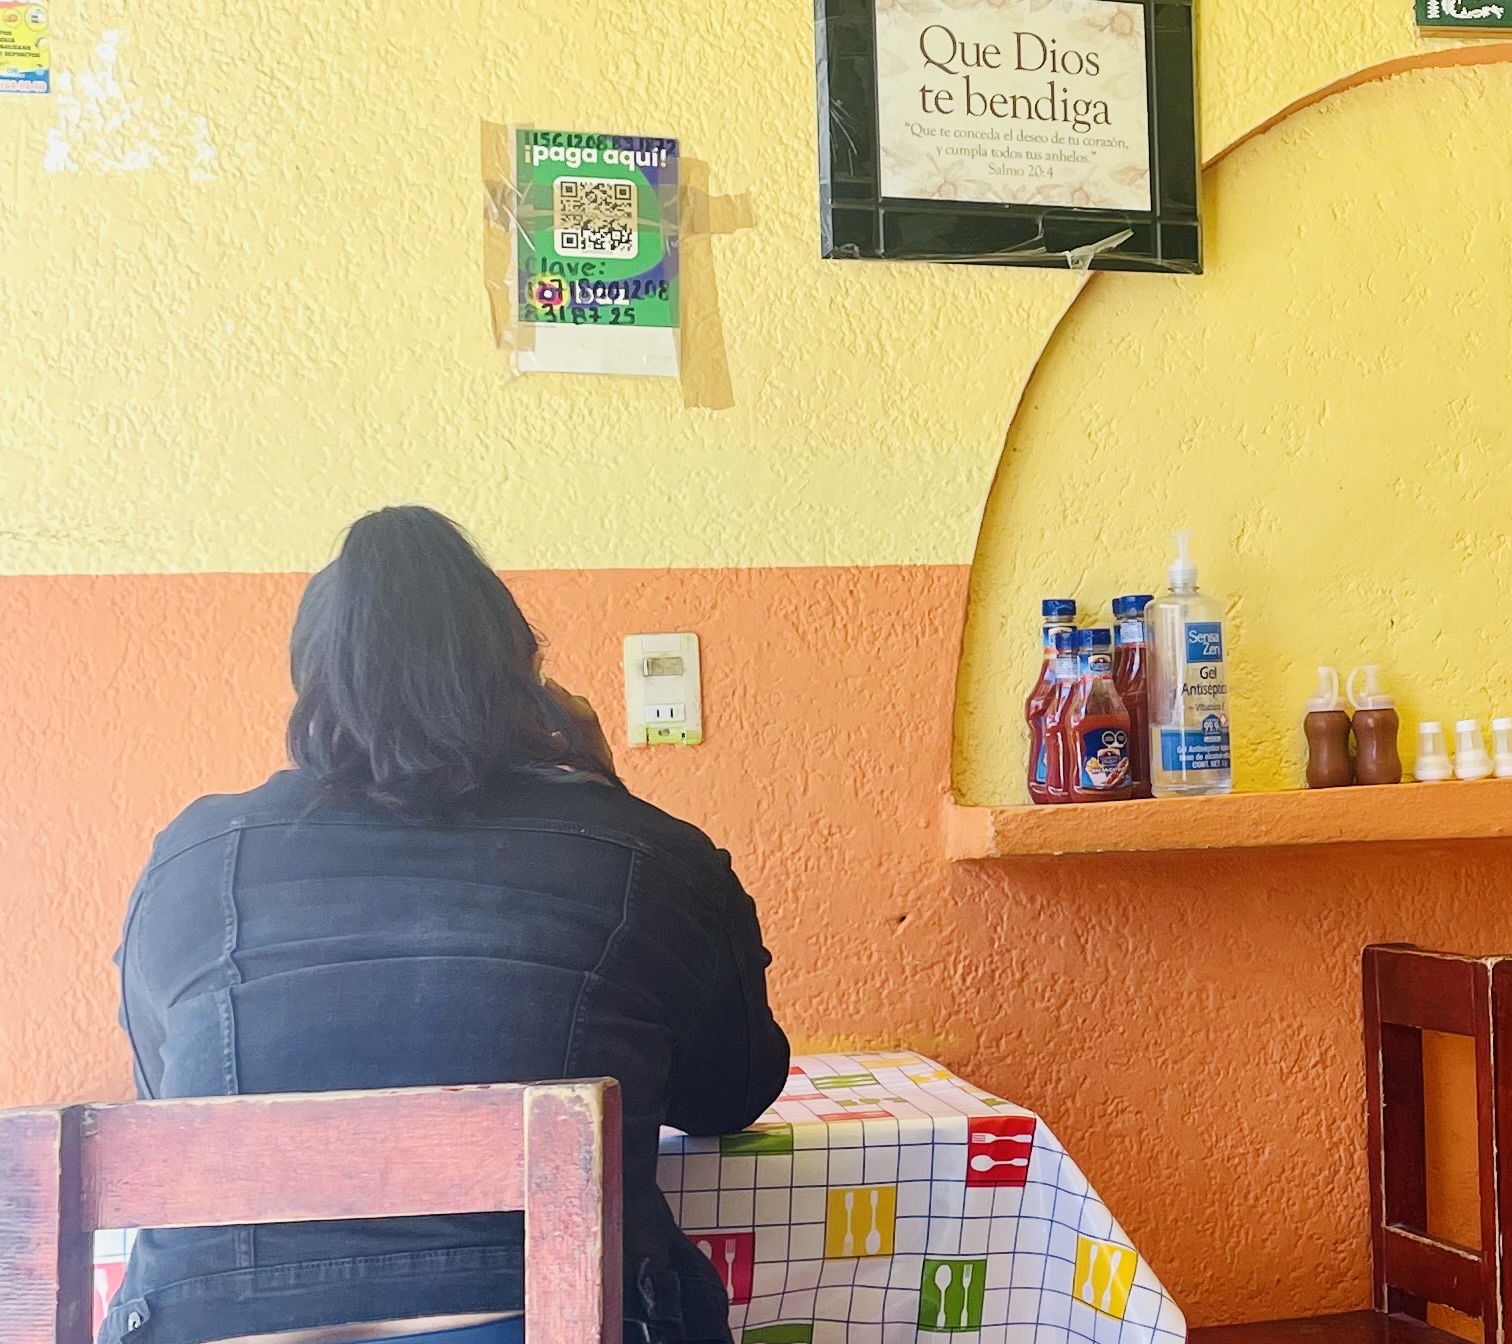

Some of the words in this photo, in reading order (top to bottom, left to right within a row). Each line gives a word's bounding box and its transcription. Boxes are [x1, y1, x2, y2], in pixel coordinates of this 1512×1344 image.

[919, 24, 1001, 75] Que
[1012, 31, 1101, 77] Dios
[919, 84, 955, 115] te
[962, 75, 1112, 134] bendiga
[940, 127, 951, 137] te
[954, 128, 1000, 141] conceda
[1004, 129, 1013, 141] el
[1017, 132, 1048, 143] deseo
[1051, 134, 1065, 145] de
[1068, 136, 1080, 145] tu
[524, 144, 597, 168] ¡paga
[602, 147, 667, 171] aquí!
[936, 145, 943, 156] y
[945, 144, 988, 159] cumpla
[992, 147, 1022, 159] todos
[1026, 150, 1042, 160] tus
[988, 163, 1025, 178] Salmo
[1028, 164, 1054, 179] 20:4
[1202, 642, 1220, 656] Zen
[1200, 666, 1217, 679] Gel
